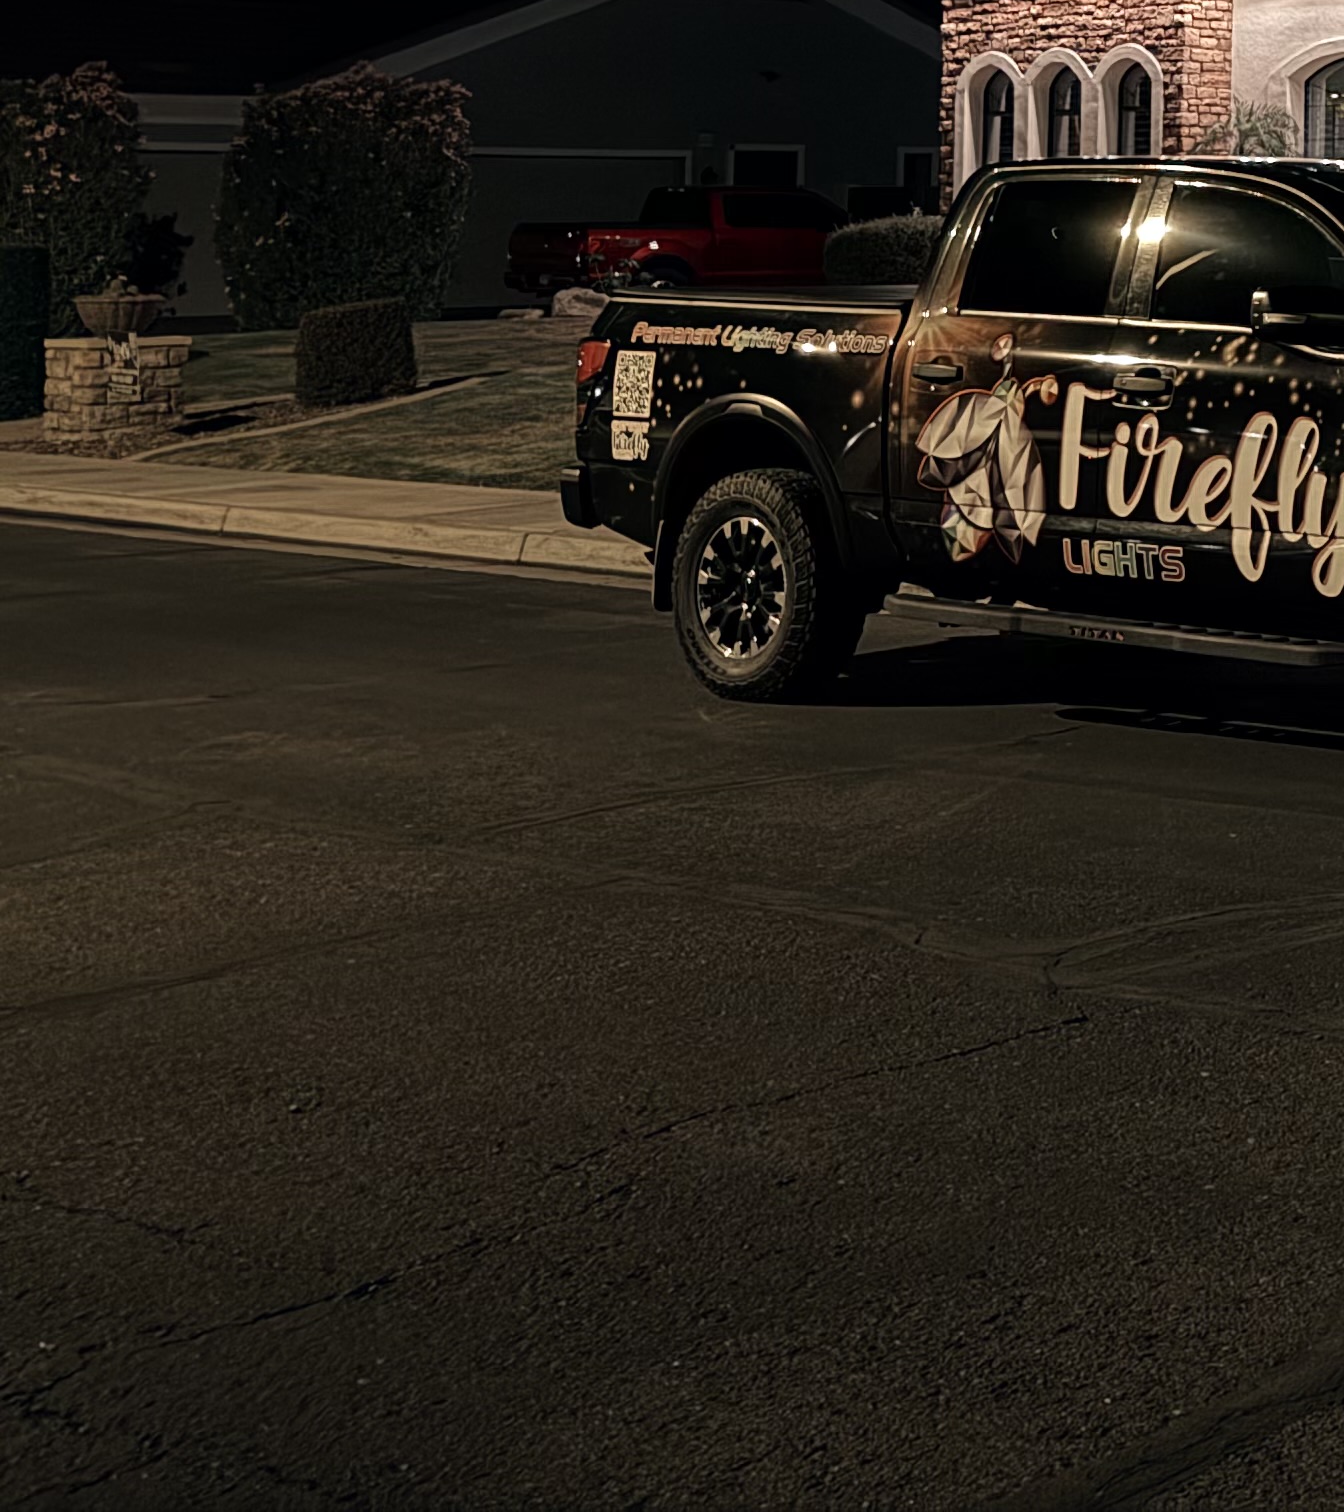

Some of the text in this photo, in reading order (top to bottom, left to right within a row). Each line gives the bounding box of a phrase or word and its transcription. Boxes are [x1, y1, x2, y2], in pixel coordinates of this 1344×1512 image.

[630, 321, 888, 354] Permanent Lighting Solutions
[1062, 538, 1187, 582] LIGHTS
